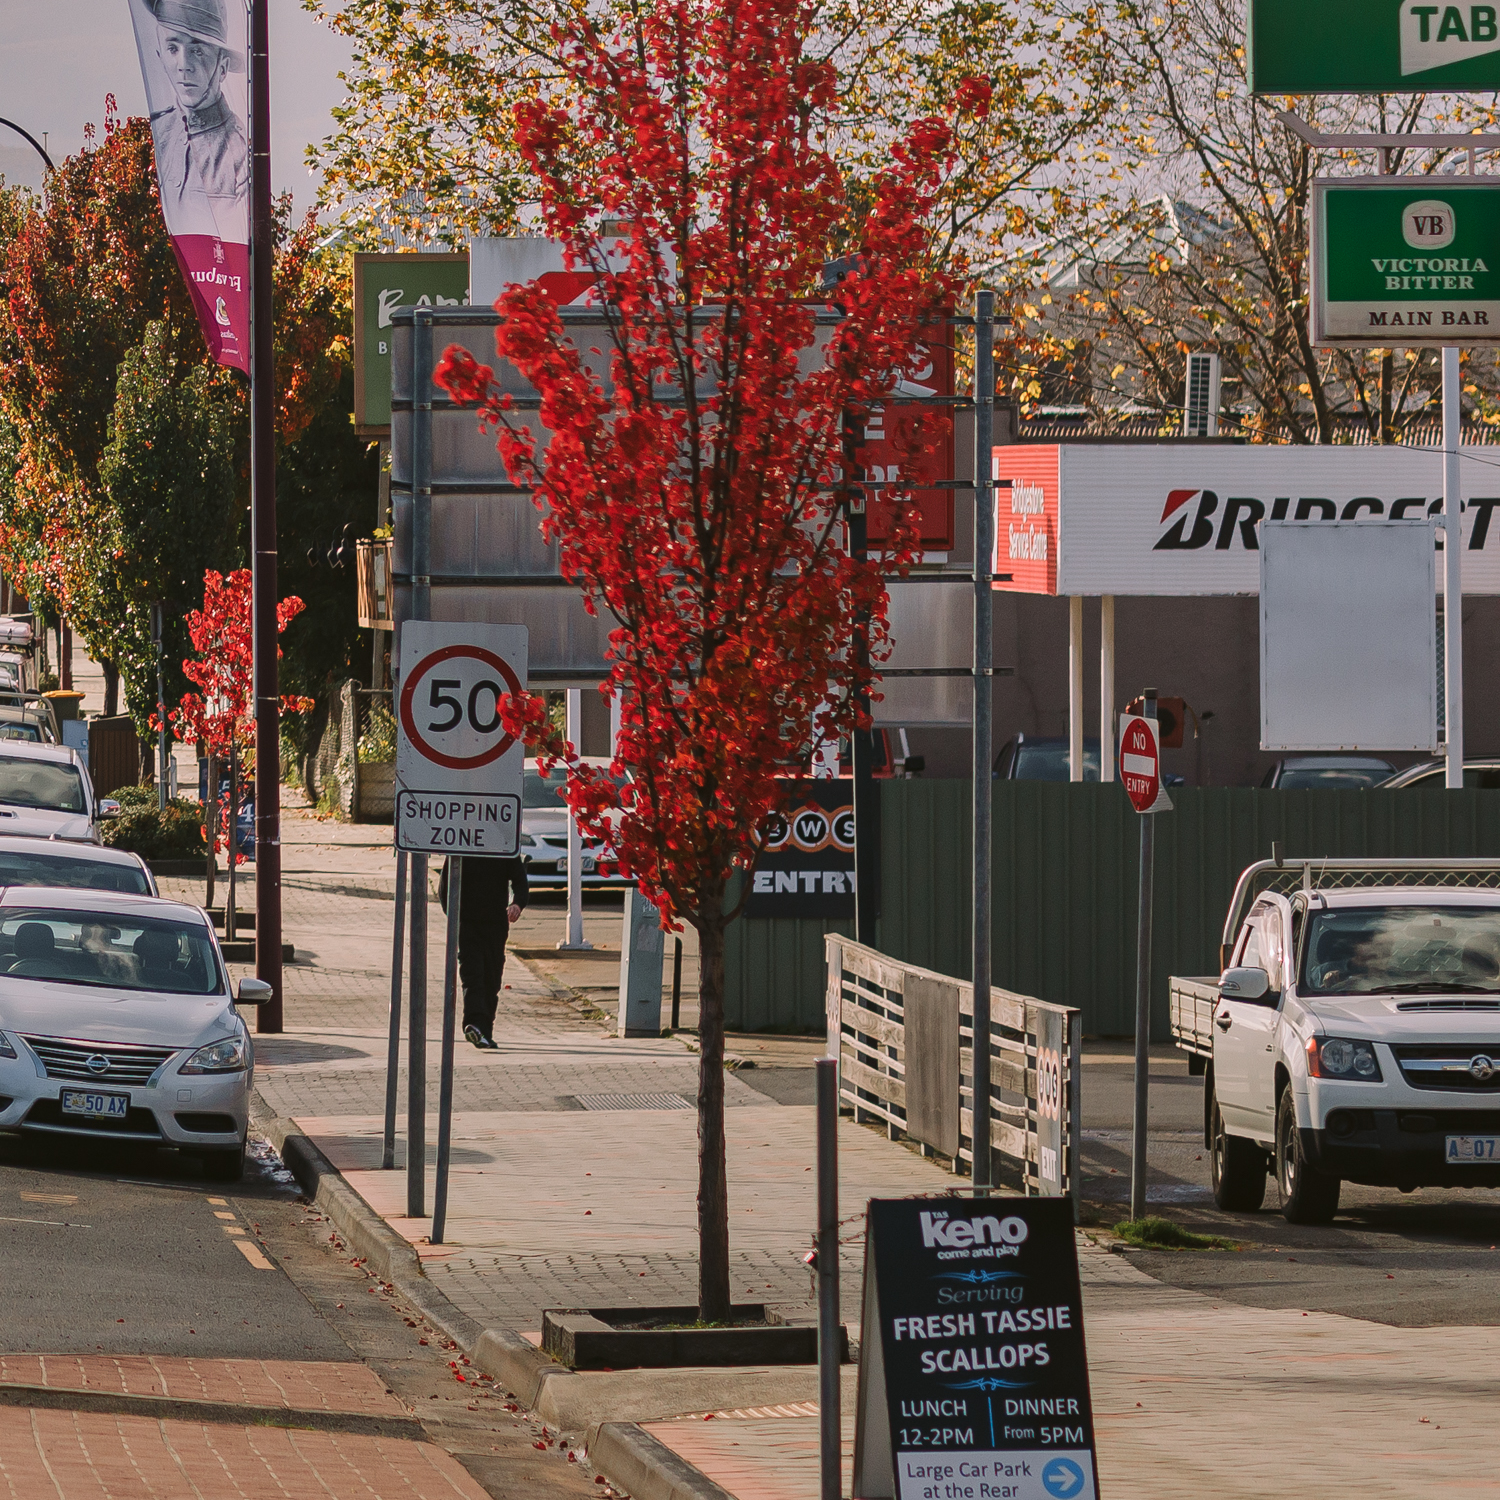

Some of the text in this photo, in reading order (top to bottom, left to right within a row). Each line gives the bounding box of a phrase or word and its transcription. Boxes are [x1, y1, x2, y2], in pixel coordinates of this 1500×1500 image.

[1410, 5, 1498, 43] TAB
[1412, 214, 1444, 236] VB
[1370, 257, 1490, 273] VICTORIA
[1384, 275, 1475, 291] BITTER
[1368, 310, 1490, 326] MAIN BAR
[427, 678, 504, 734] 50
[1132, 731, 1147, 751] NO
[1126, 777, 1151, 795] ENTRY
[405, 800, 513, 823] SHOPPING
[429, 826, 485, 847] ZONE
[752, 870, 857, 894] ENTRY
[63, 1092, 127, 1114] E 50 AX
[1447, 1139, 1496, 1158] A 07
[931, 1209, 949, 1219] TAS
[936, 1244, 1020, 1260] come and play
[936, 1283, 1025, 1305] Serving
[893, 1305, 1073, 1341] FRESH TASSIE
[920, 1342, 1051, 1374] SCALLOPS
[901, 1399, 968, 1418] LUNCH
[1004, 1398, 1081, 1417] DINNER
[899, 1427, 975, 1446] 12-2PM
[1003, 1425, 1085, 1444] From 5PM
[905, 1459, 1033, 1483] Large Car Park
[922, 1481, 1020, 1499] at the Rear
